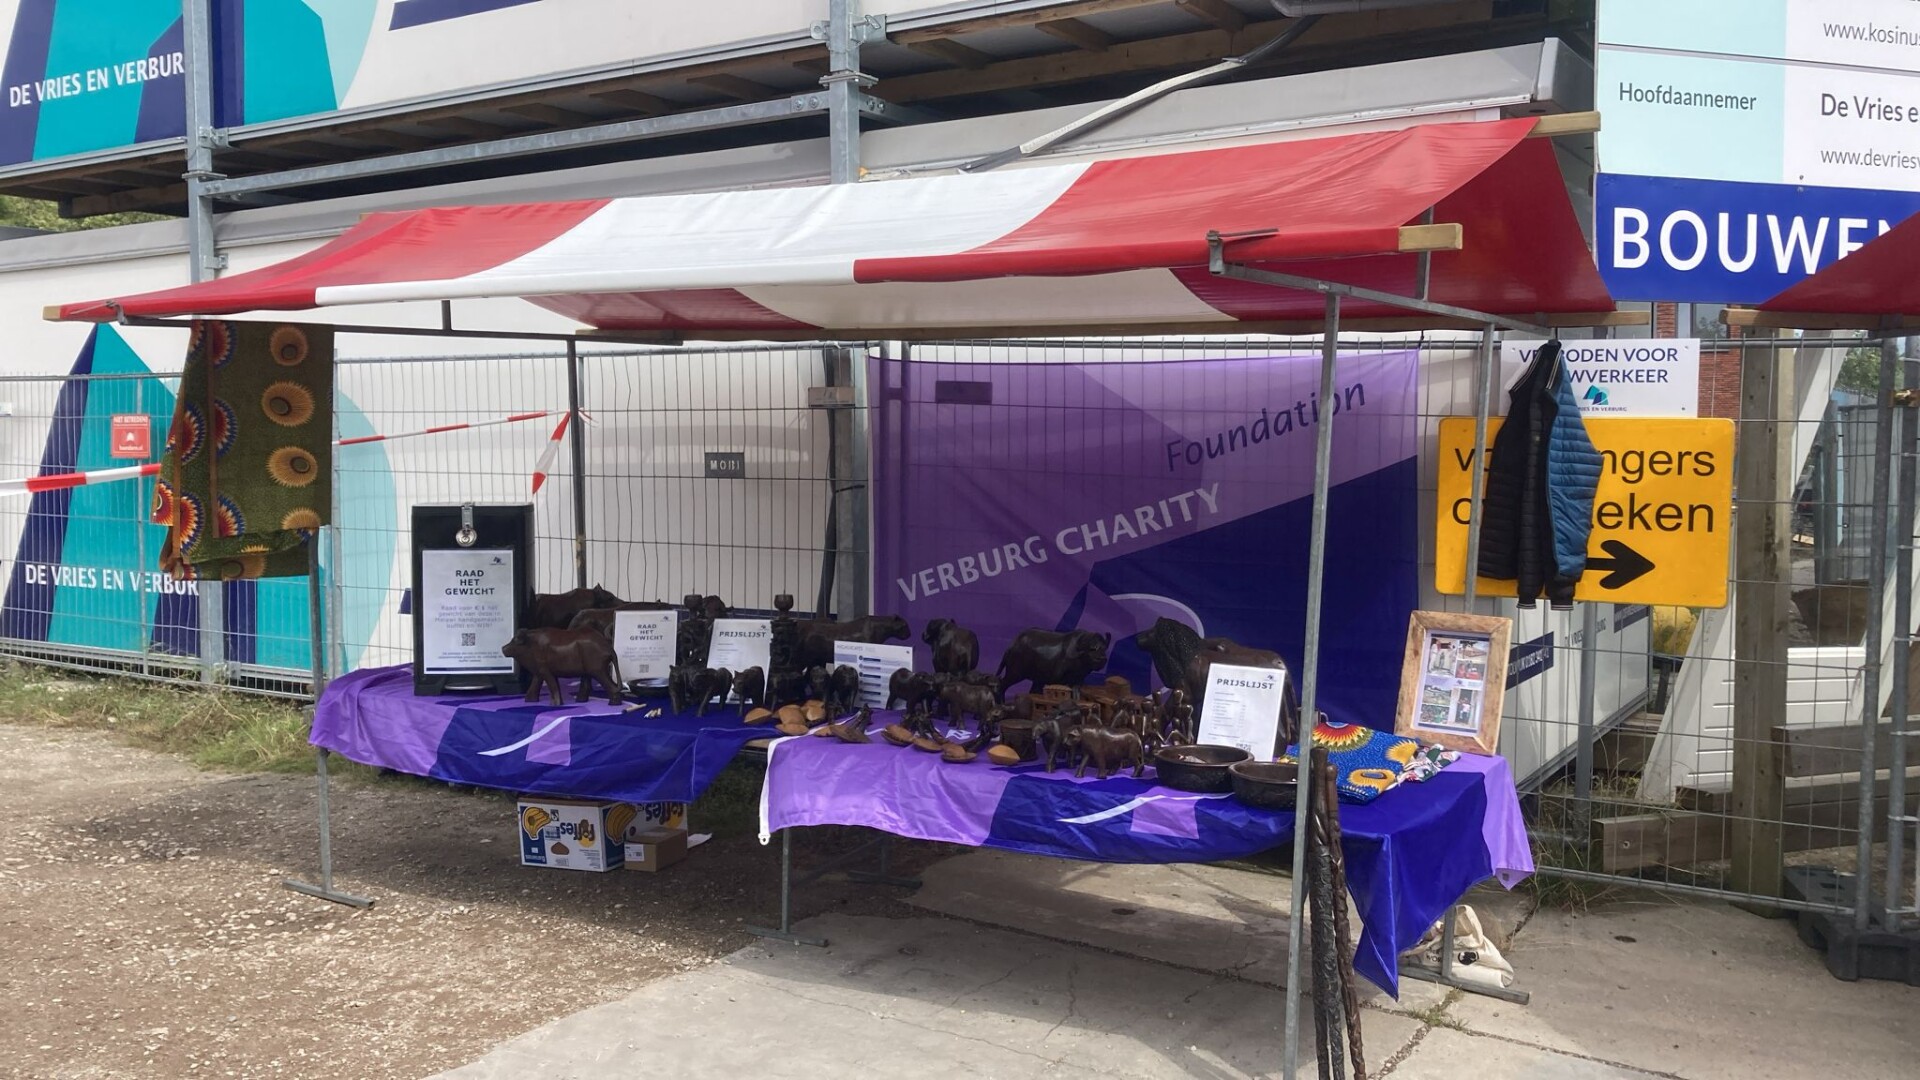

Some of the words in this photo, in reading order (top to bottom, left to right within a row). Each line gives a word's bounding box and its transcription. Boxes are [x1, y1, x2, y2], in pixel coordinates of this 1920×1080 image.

[1823, 22, 1920, 46] www.kosinu
[9, 84, 31, 107] DE
[35, 73, 81, 102] VRIES
[86, 67, 109, 92] EN
[113, 52, 185, 86] VERBUR
[1619, 82, 1757, 110] Hoofdaannemer
[1821, 93, 1849, 117] De
[1853, 95, 1903, 122] Vries
[1622, 348, 1678, 362] VOOR
[897, 536, 1048, 602] VERBURG
[1055, 482, 1220, 556] CHARITY
[25, 564, 47, 585] DE
[51, 565, 97, 589] VRIES
[102, 568, 124, 590] EN
[129, 571, 200, 596] VERBUR
[1216, 678, 1274, 690] PRIJSLIJST
